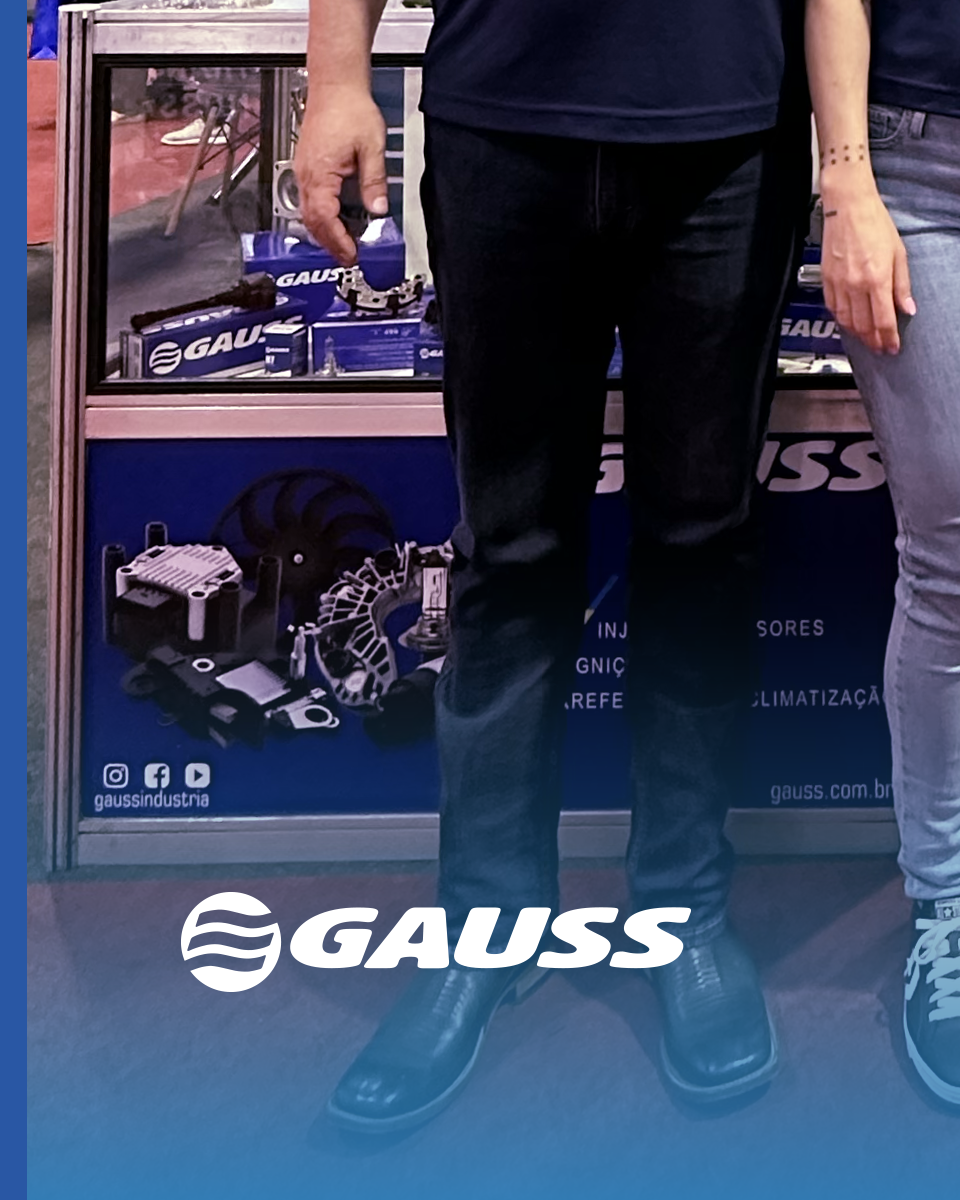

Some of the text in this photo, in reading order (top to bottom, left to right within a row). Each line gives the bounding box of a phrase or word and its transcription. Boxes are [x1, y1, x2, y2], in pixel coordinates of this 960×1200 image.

[276, 265, 359, 288] GAUS
[598, 622, 628, 639] INJ
[757, 620, 825, 637] SORES
[576, 657, 626, 677] GNIÇ
[564, 692, 624, 709] REFE
[752, 686, 885, 709] LIMATIZAÇÃ
[94, 790, 209, 811] gaussindustria
[771, 778, 893, 804] gauss.com.br
